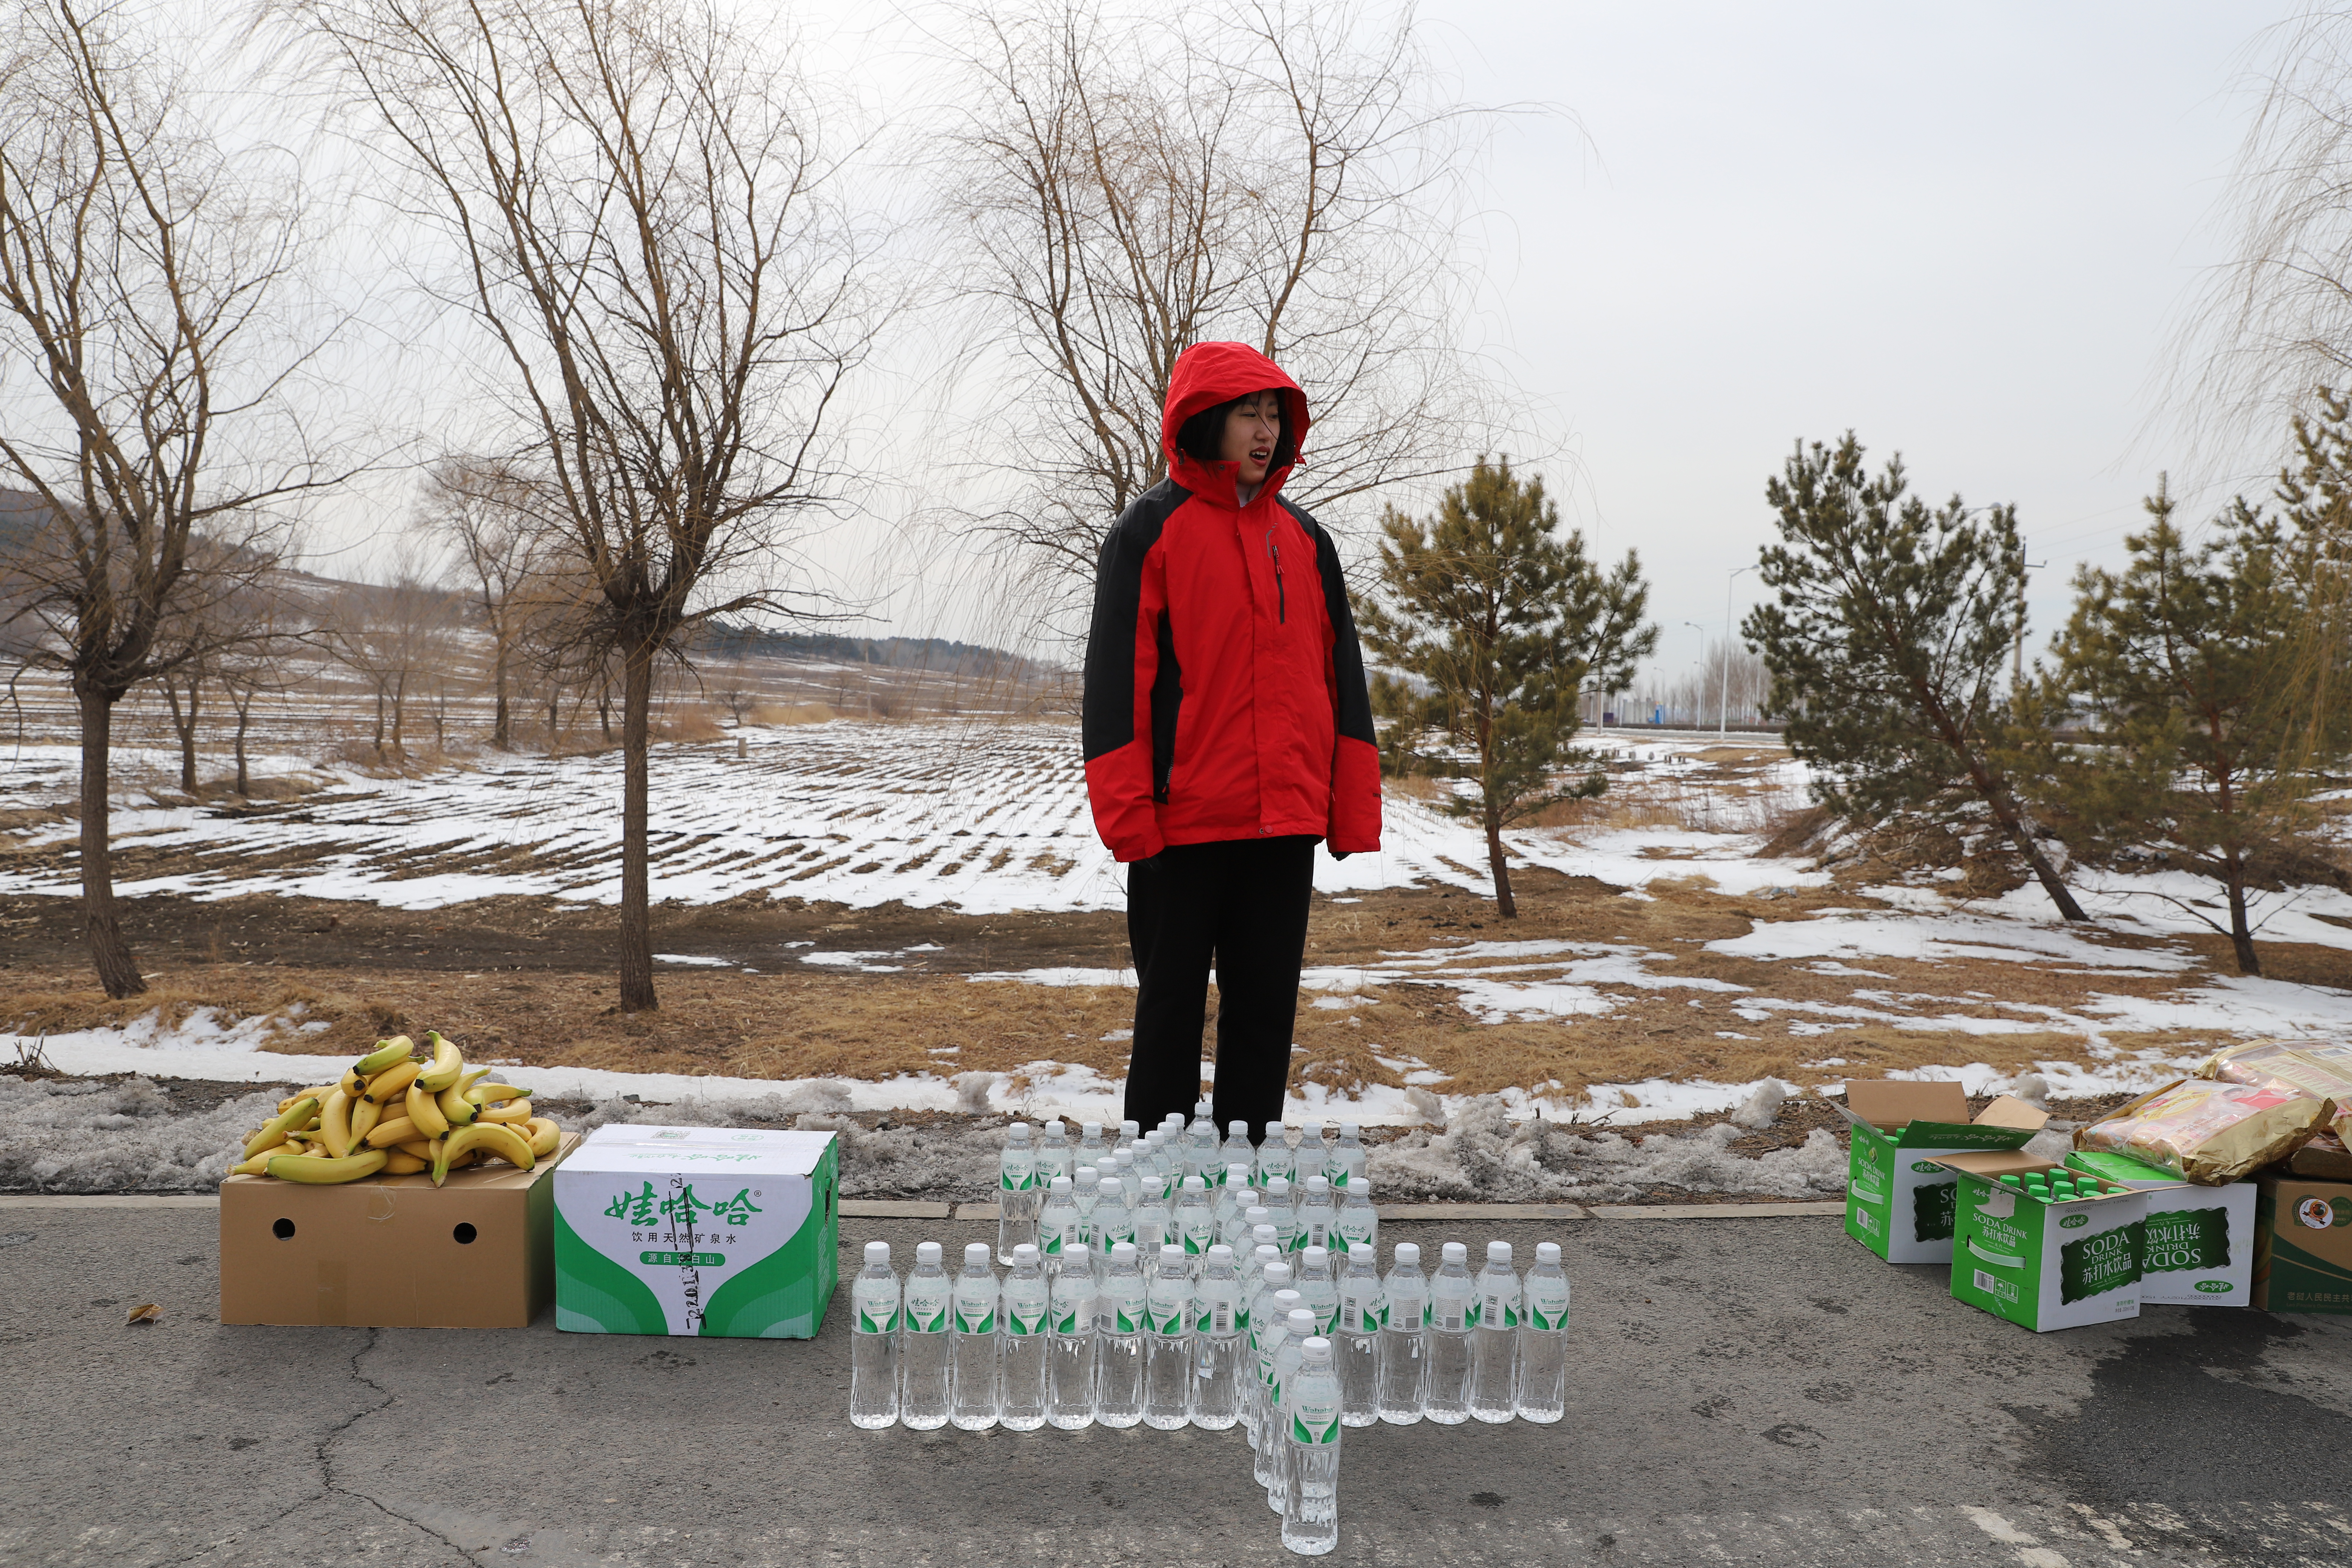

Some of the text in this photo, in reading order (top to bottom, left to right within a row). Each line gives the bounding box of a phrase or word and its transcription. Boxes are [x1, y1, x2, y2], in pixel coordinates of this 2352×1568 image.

[1858, 1157, 1885, 1180] SODA DRINK
[604, 1181, 762, 1226] 娃哈哈
[1973, 1213, 2027, 1240] SODA DRINK
[2063, 1216, 2085, 1227] 娃哈哈
[632, 1231, 737, 1244] 饮用天然矿泉水
[1982, 1226, 2015, 1248] 苏打水饮品
[2145, 1222, 2201, 1245] 苏打水饮
[2083, 1231, 2130, 1259] SODA
[2145, 1242, 2189, 1253] DRINK
[2092, 1247, 2123, 1264] DRINK
[2142, 1248, 2201, 1269] SODA
[2082, 1252, 2132, 1285] 苏打水饮品
[2199, 1282, 2229, 1292] 娃哈哈
[911, 1298, 939, 1306] 娃哈哈
[1150, 1298, 1174, 1308] Wahaha
[2287, 1292, 2352, 1303] 老挝人民民主共
